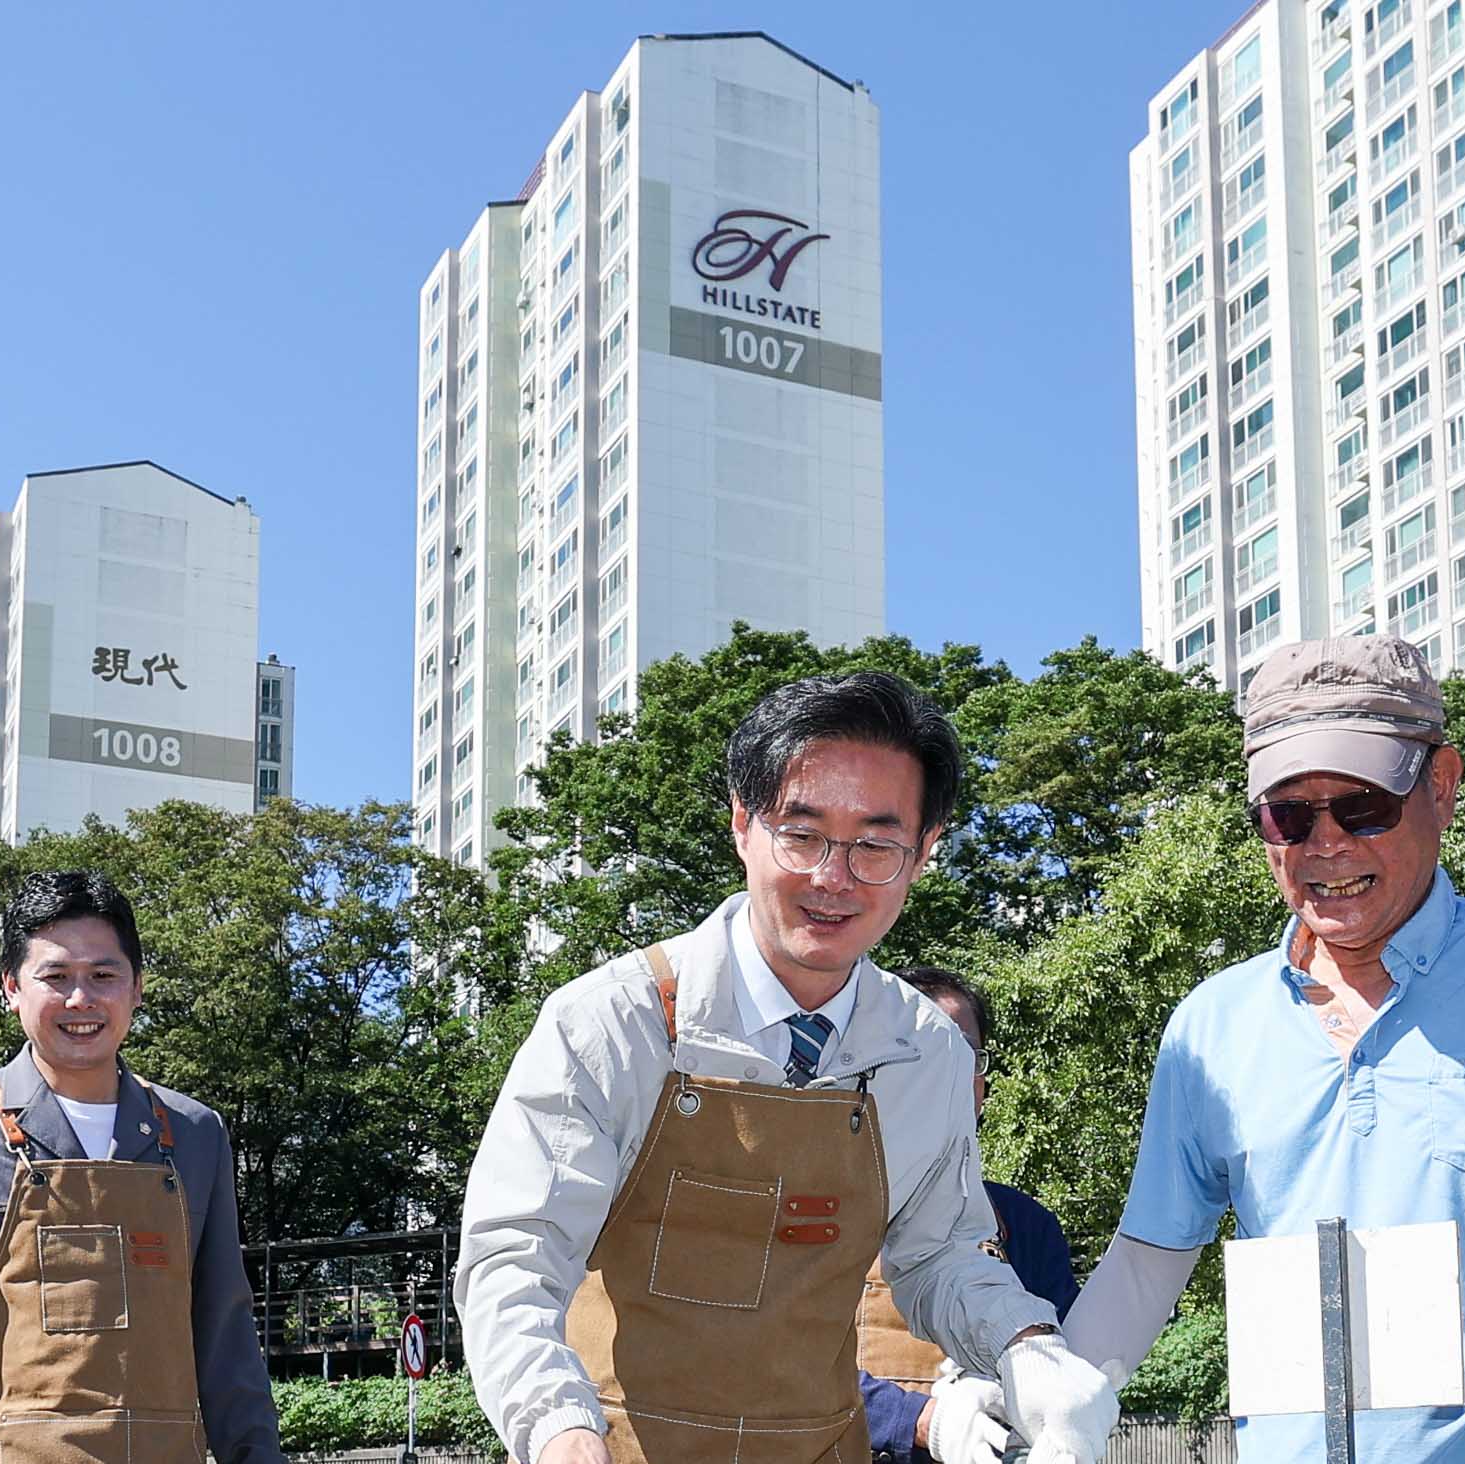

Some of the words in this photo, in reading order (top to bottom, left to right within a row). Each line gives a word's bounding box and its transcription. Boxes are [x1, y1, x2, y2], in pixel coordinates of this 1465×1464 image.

[702, 284, 822, 329] HILLSTATE
[720, 326, 805, 374] 1007
[91, 647, 188, 690] 現代
[93, 727, 181, 767] 1008
